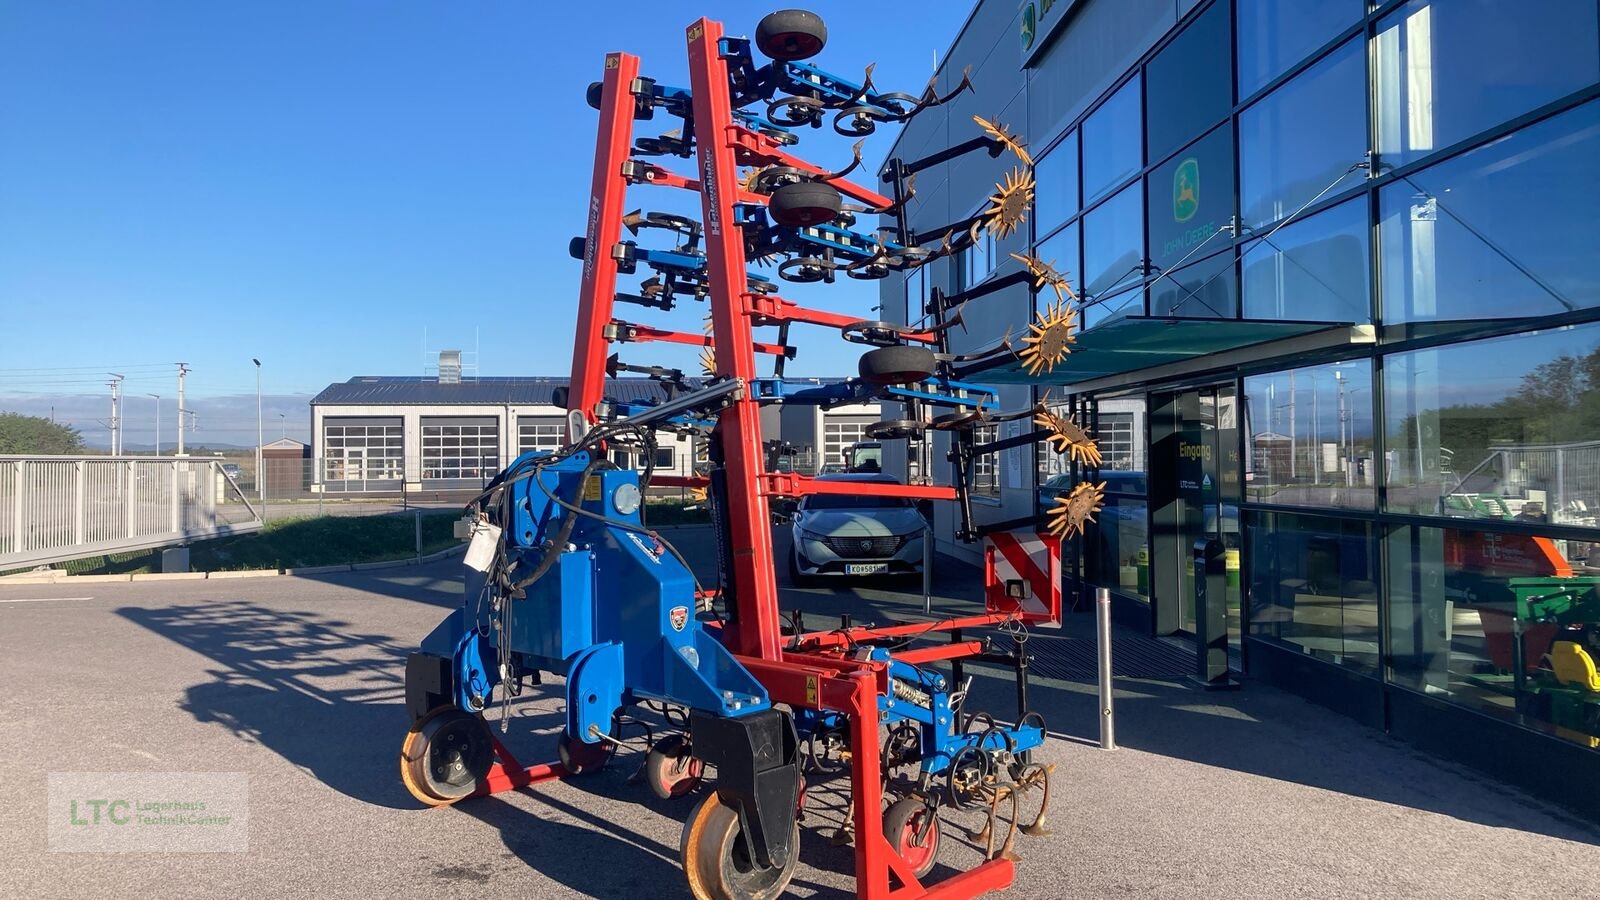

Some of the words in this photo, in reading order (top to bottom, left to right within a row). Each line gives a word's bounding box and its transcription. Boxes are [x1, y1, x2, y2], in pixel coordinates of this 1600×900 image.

[1162, 236, 1184, 257] JOHN
[1185, 222, 1214, 246] DEERE
[1180, 442, 1211, 461] Eingang
